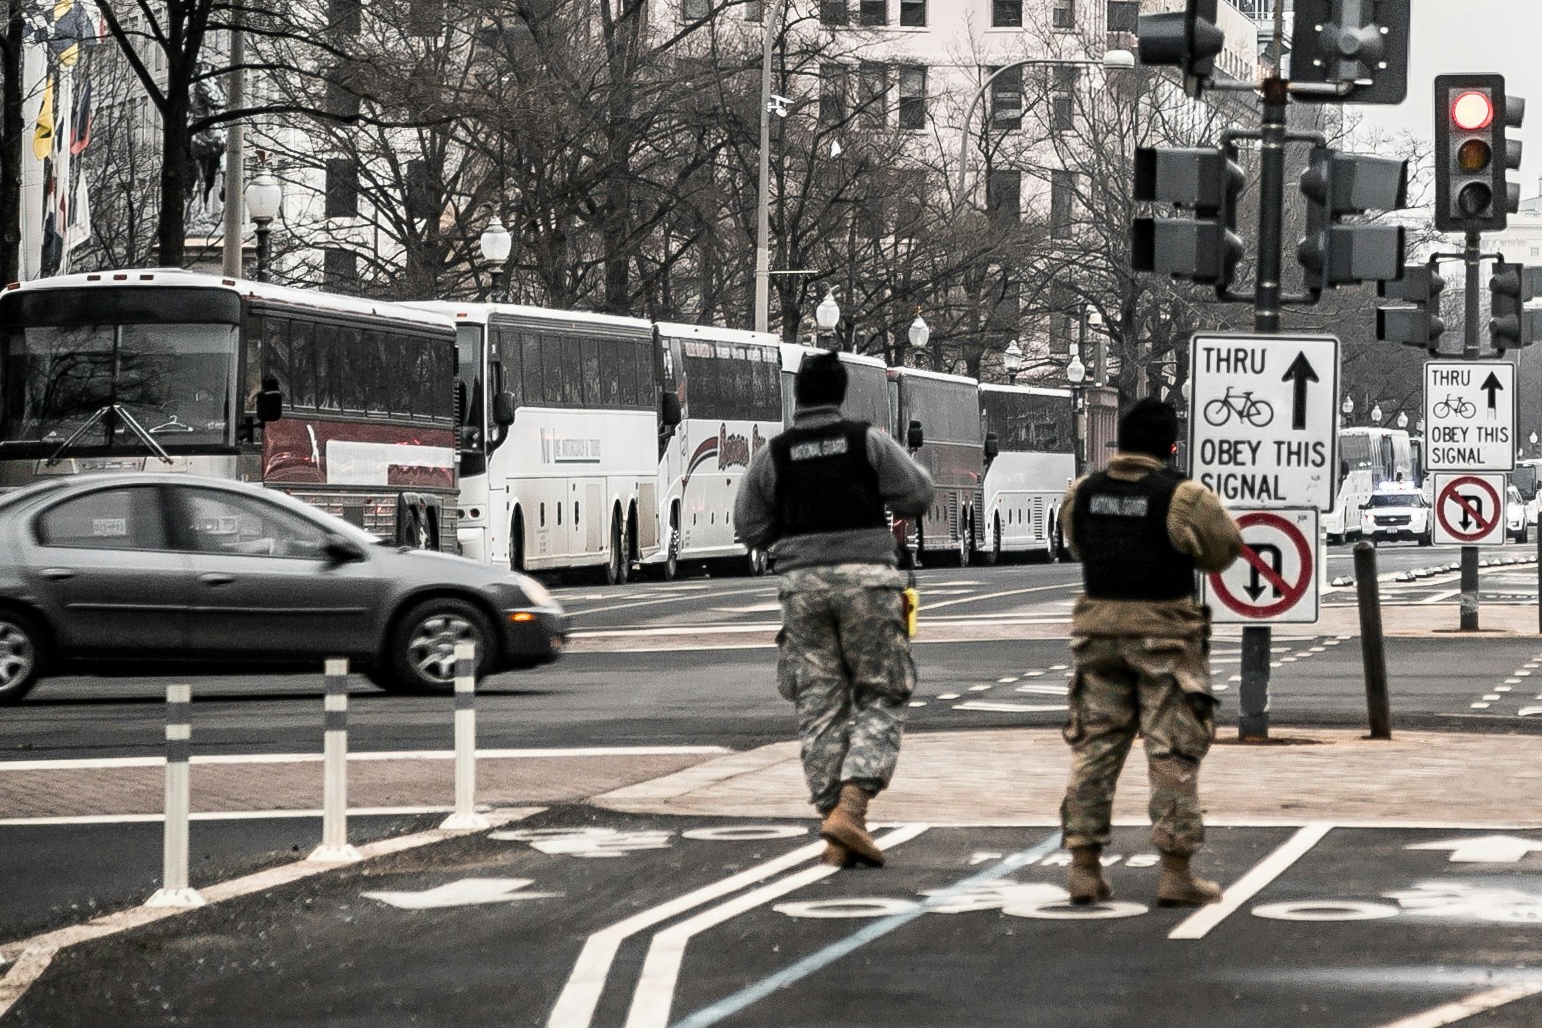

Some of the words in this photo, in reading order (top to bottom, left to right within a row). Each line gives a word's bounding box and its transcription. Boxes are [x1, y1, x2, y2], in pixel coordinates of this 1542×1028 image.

[1202, 347, 1267, 375] THRU
[1431, 369, 1471, 386] THRU
[1432, 426, 1469, 443] OBEY
[1476, 426, 1509, 443] THIS
[1200, 438, 1262, 466] OBEY
[1273, 440, 1326, 468] THIS
[1431, 447, 1485, 464] SIGNAL
[1201, 473, 1287, 501] SIGNAL
